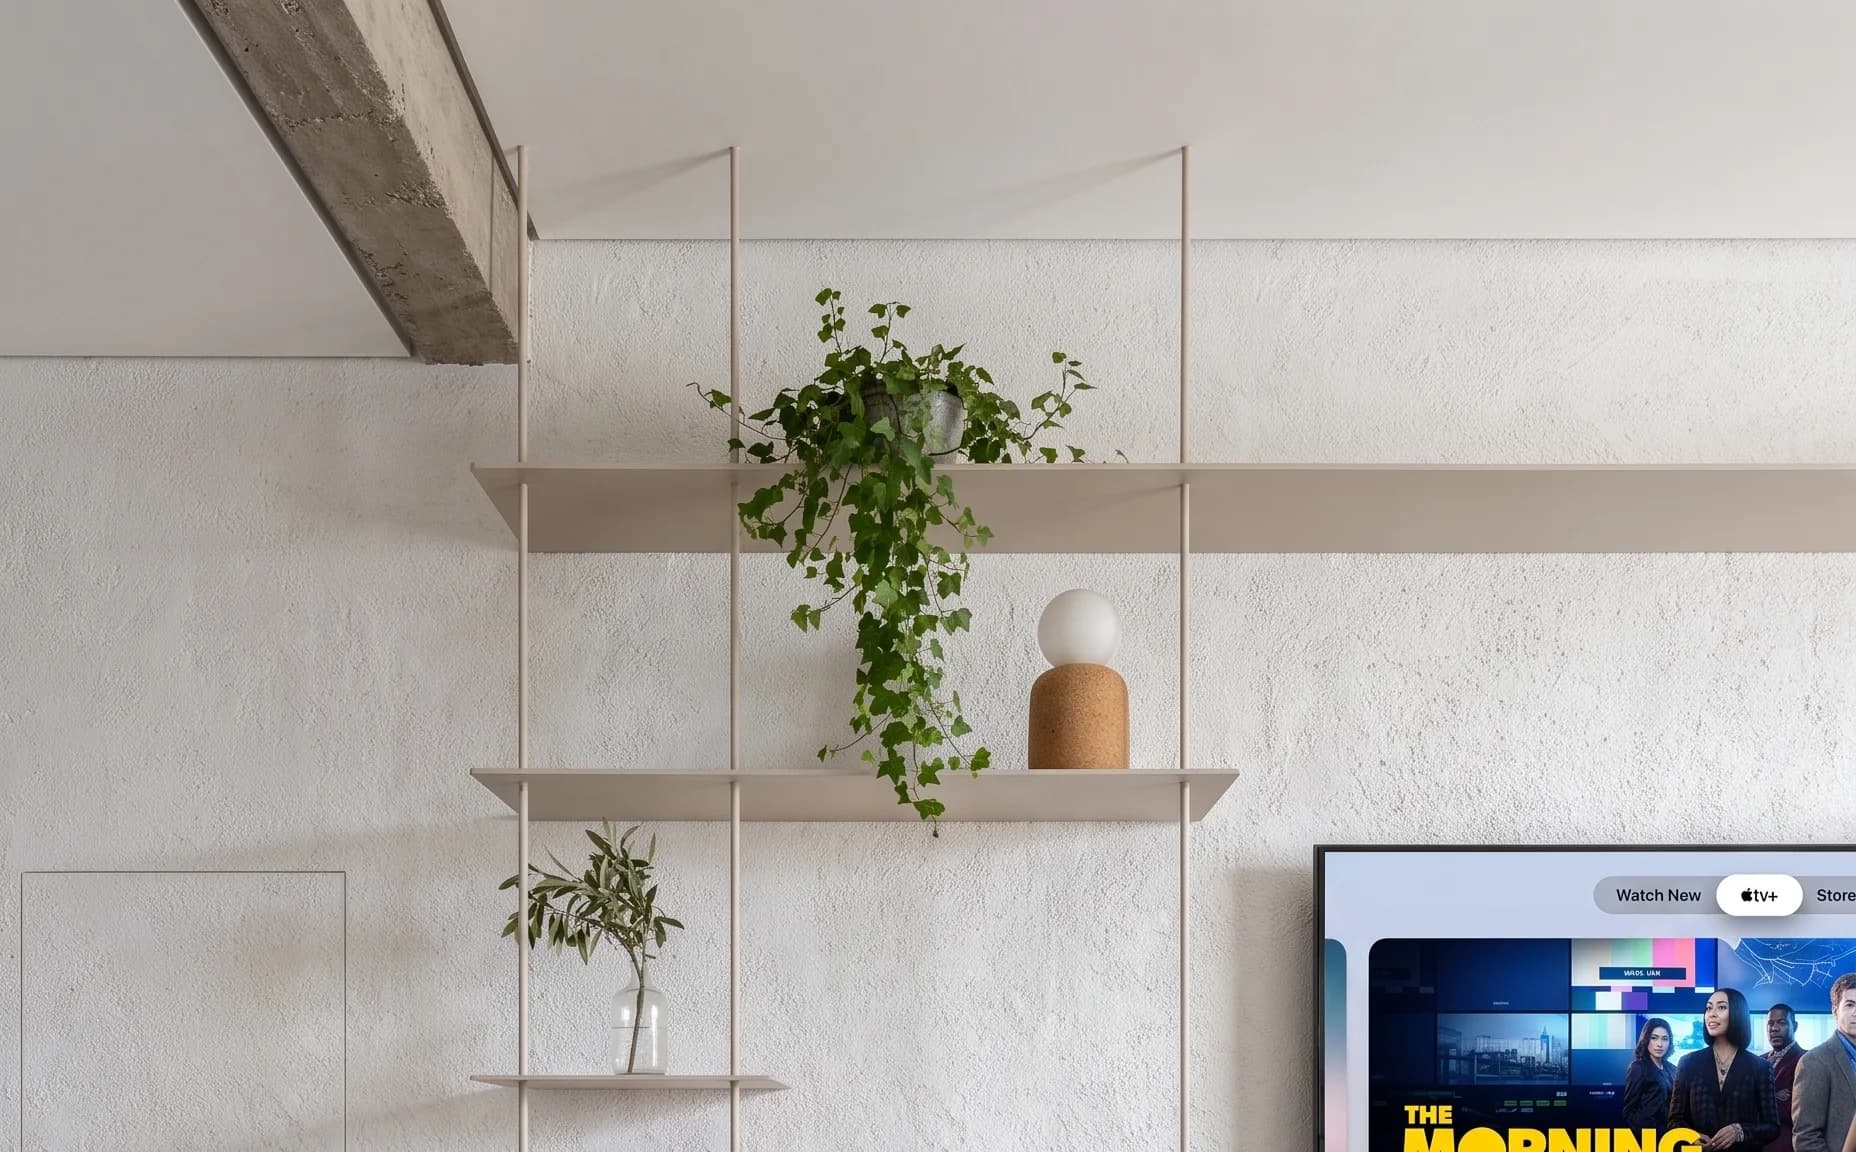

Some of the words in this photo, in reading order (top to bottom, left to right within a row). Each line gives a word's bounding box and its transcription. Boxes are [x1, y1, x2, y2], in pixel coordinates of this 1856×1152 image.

[1616, 888, 1664, 902] Watch
[1668, 888, 1702, 902] New
[1817, 888, 1856, 902] Store
[1404, 1105, 1453, 1124] THE
